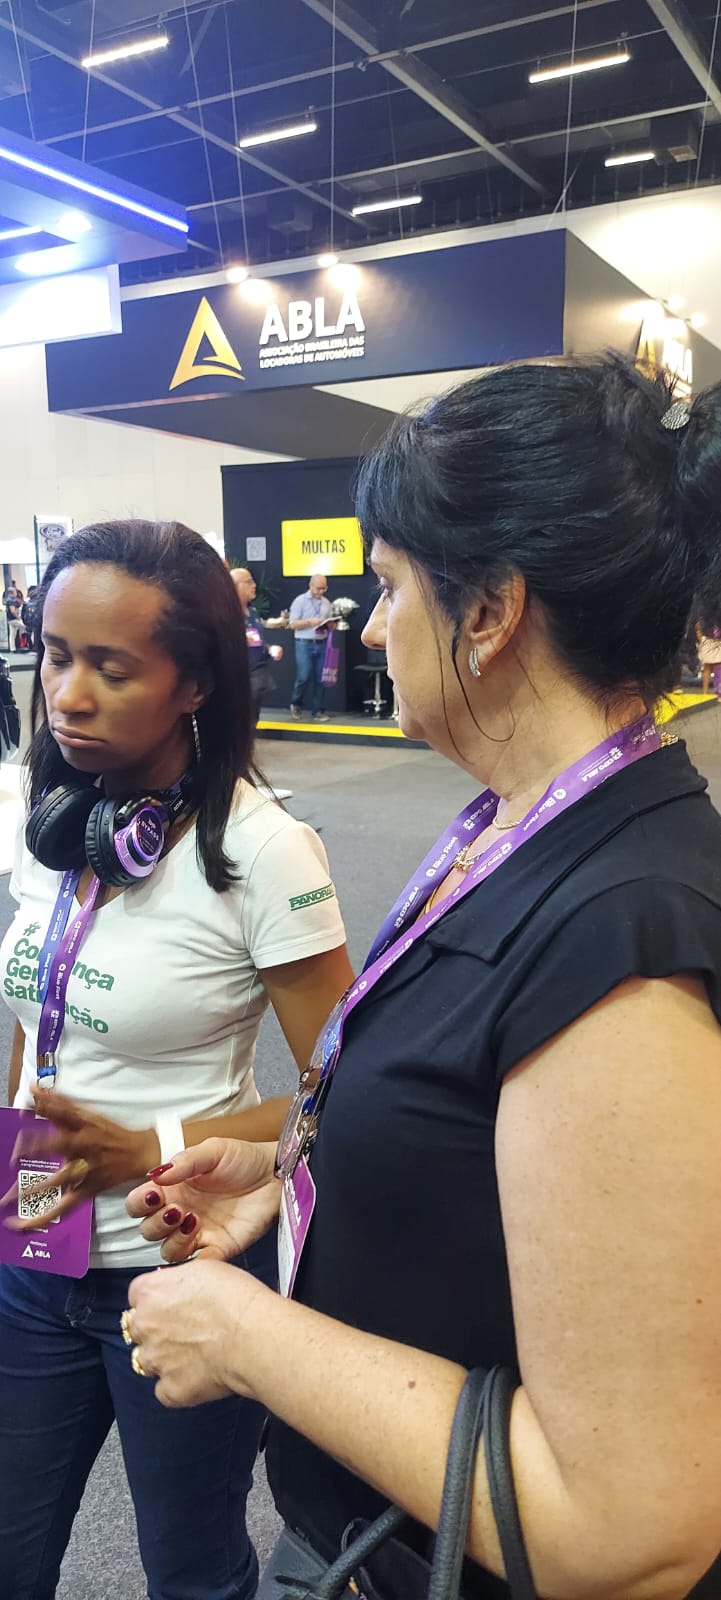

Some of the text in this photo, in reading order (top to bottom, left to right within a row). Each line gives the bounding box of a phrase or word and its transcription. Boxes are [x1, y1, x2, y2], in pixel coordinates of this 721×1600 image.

[259, 292, 366, 345] ABLA
[259, 335, 365, 358] ASSOCIAÇÃO BRASILEIRA DAS
[259, 346, 365, 369] LOCADORAS DE AUTOMÓVEIS
[301, 539, 346, 555] MULTAS
[539, 797, 556, 813] Blue
[433, 853, 447, 868] Blue
[290, 887, 334, 908] PANORA
[22, 921, 41, 936] #
